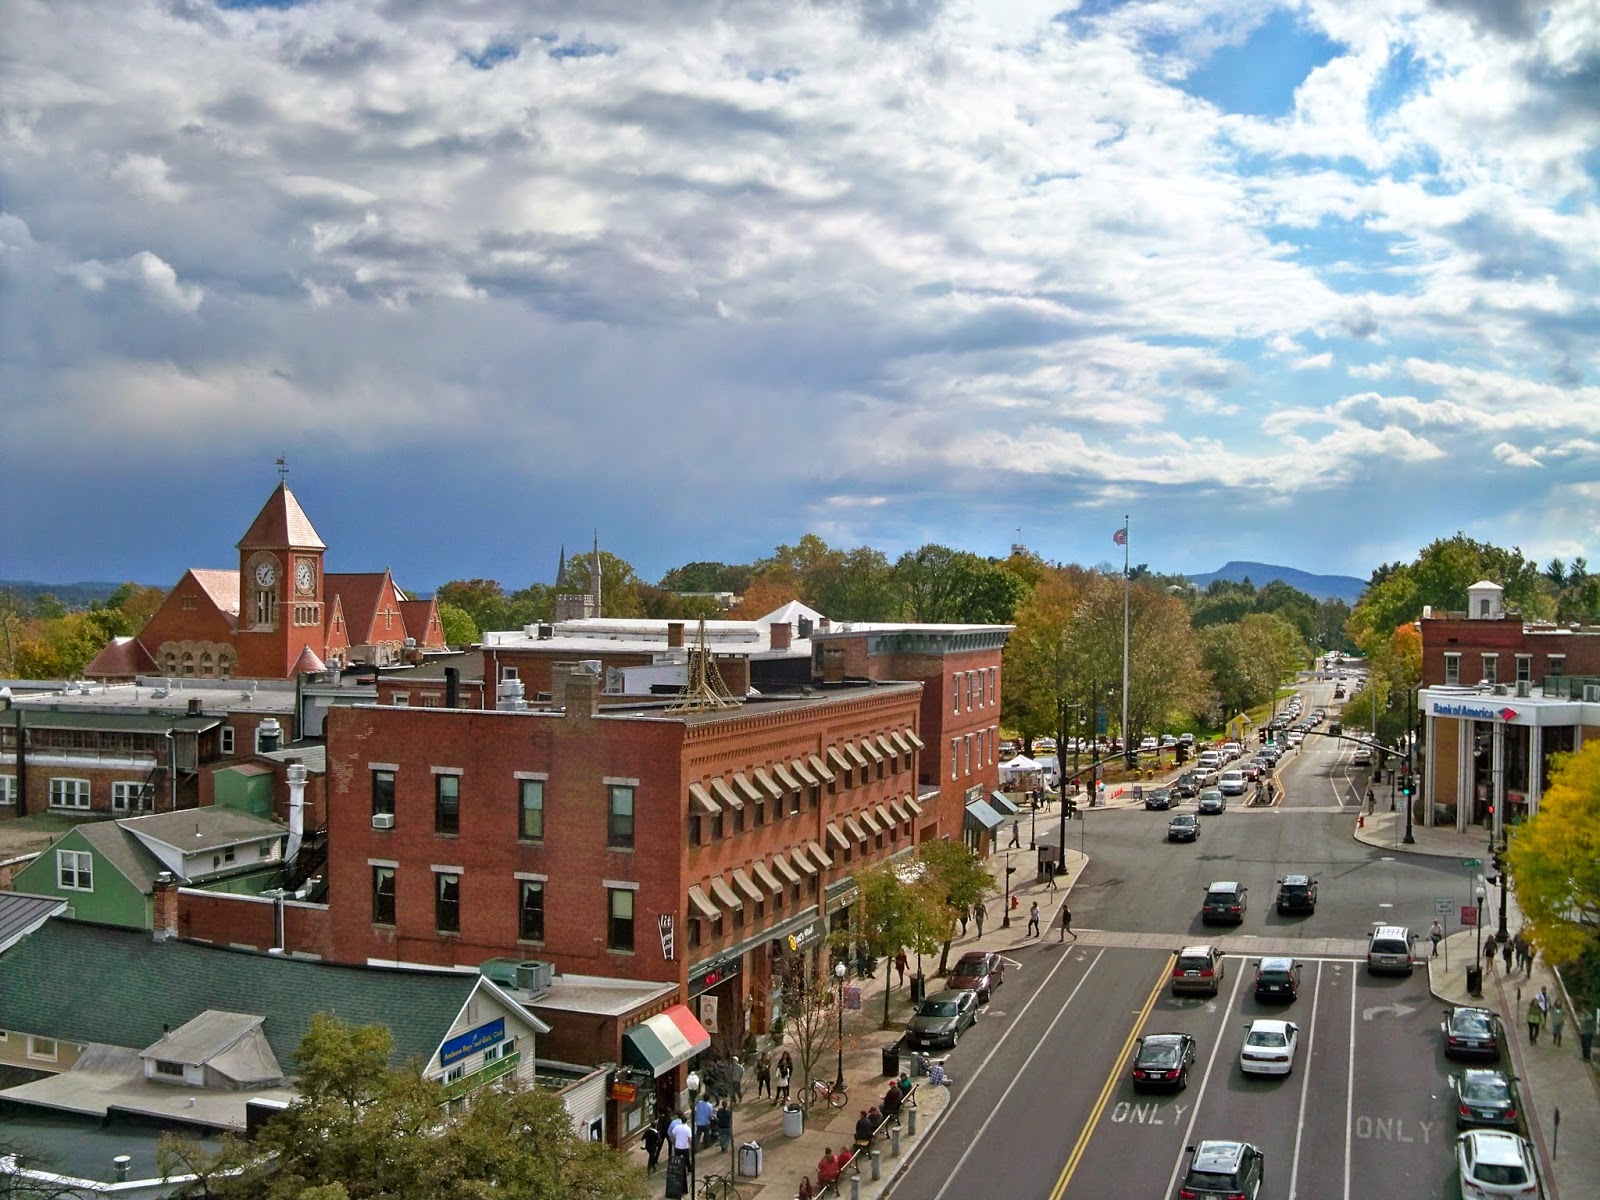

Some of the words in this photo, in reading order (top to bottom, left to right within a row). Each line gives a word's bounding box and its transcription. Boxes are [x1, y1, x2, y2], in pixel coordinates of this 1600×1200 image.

[1433, 703, 1451, 714] Bank
[1452, 705, 1462, 715] of
[1462, 705, 1494, 718] America
[1111, 1102, 1188, 1125] ONLY
[1356, 1115, 1433, 1144] ONLY
